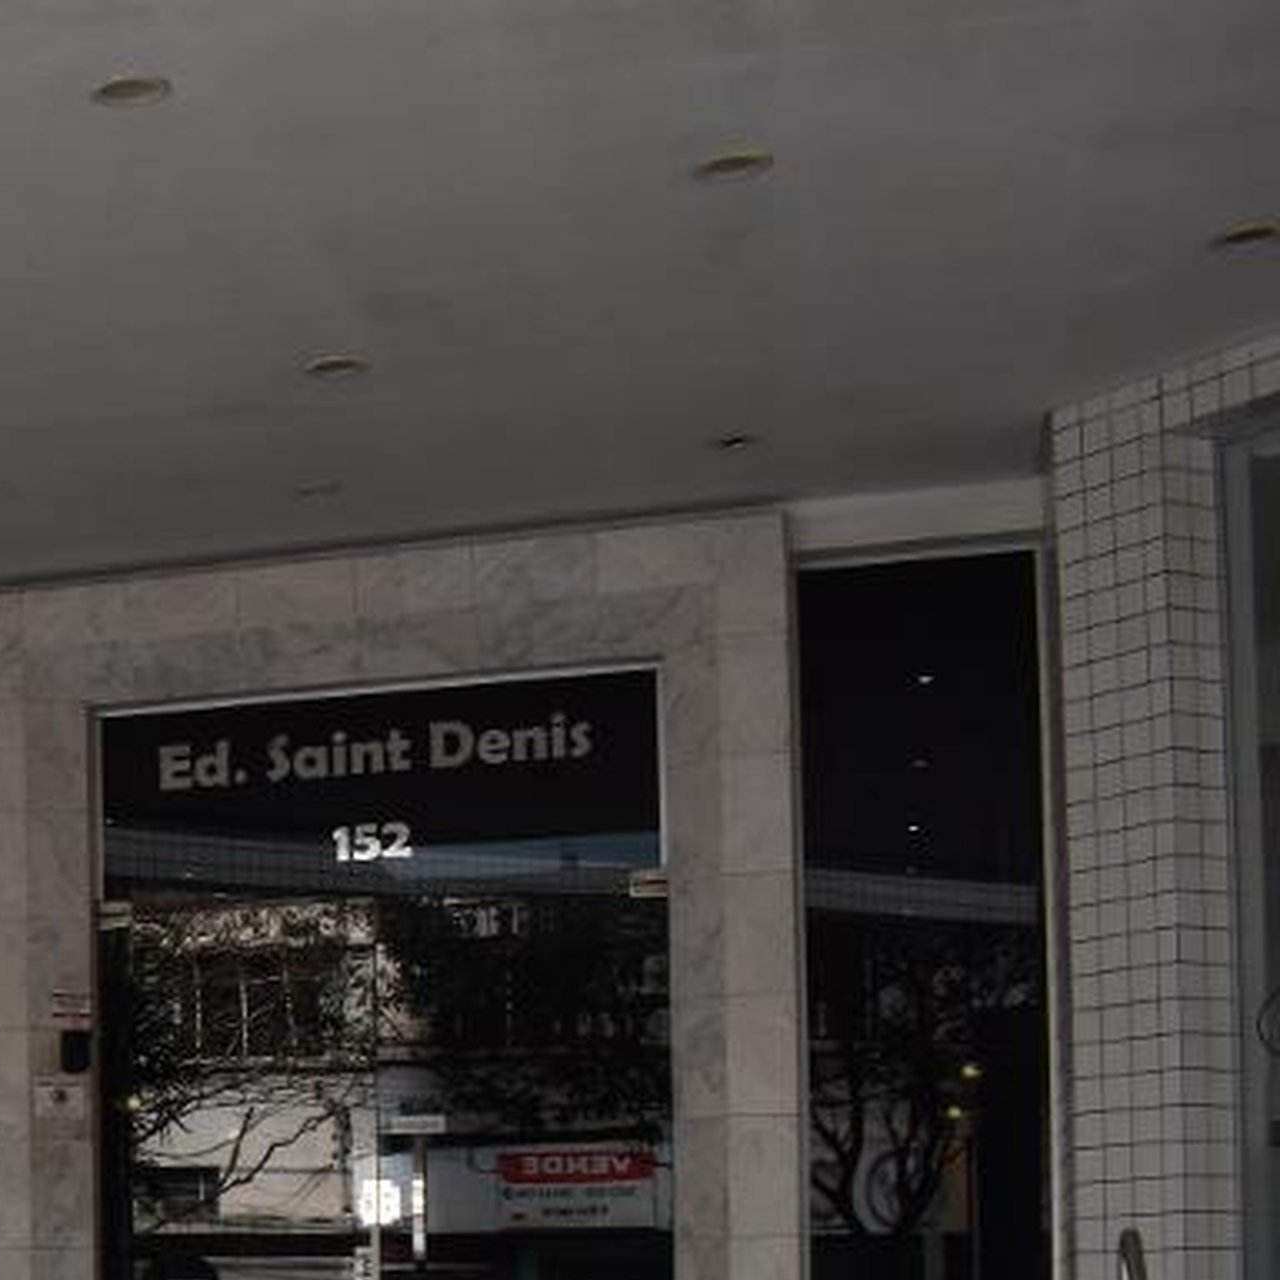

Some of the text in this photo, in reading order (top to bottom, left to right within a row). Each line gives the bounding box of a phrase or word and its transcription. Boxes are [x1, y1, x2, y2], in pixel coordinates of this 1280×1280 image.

[159, 712, 592, 791] Ed. Saint Denis
[332, 821, 414, 862] 152
